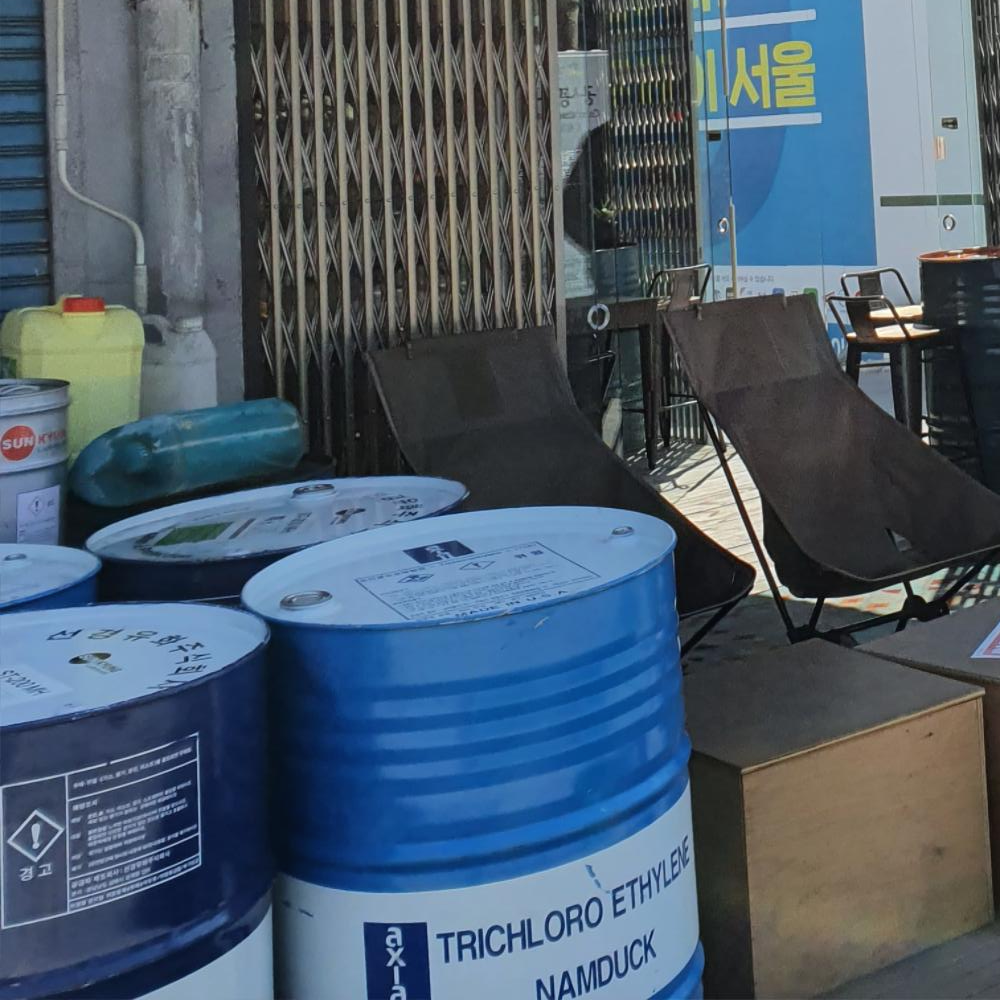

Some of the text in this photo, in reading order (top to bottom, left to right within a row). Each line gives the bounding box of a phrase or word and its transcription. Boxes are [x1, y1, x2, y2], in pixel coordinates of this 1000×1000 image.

[730, 40, 817, 110] 서울
[2, 436, 34, 450] SUN
[19, 863, 53, 882] 경고
[436, 835, 691, 964] TRICHLORO ETHYLENE
[536, 928, 657, 1000] NAMDUCK
